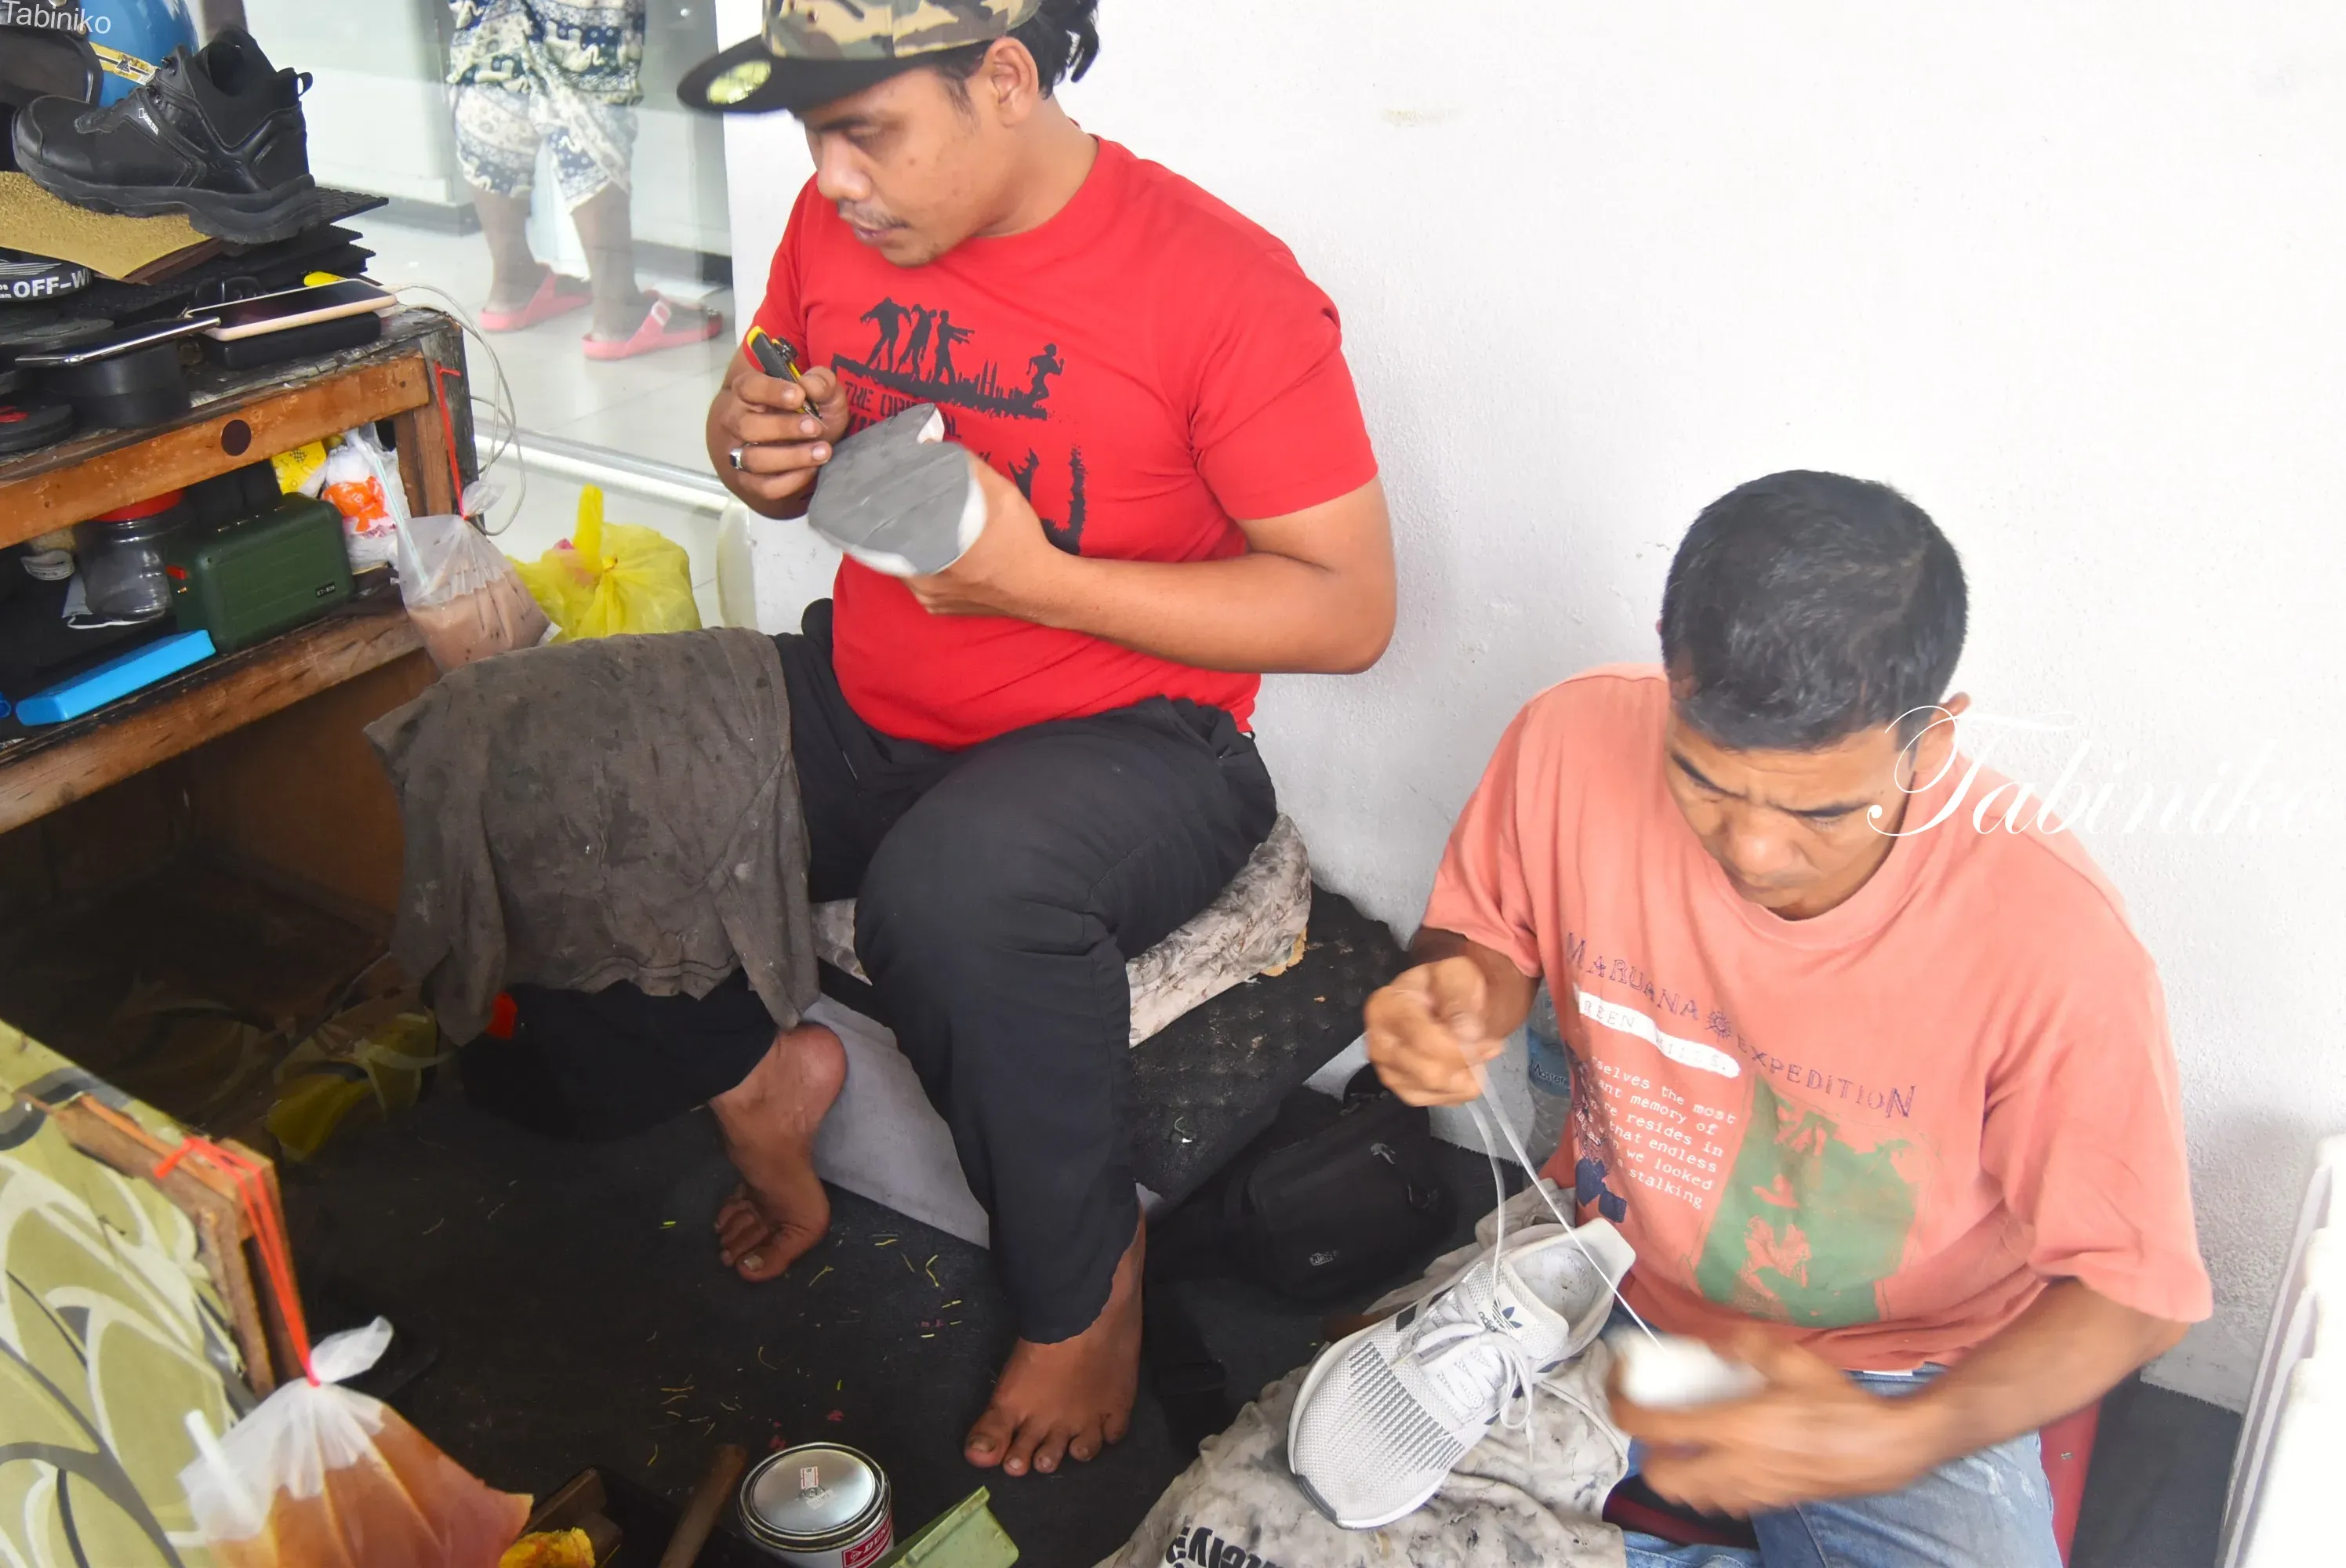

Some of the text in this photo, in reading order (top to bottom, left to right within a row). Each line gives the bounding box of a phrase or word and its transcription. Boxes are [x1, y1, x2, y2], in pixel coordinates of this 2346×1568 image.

[844, 380, 874, 412] THE
[1567, 931, 1916, 1119] MARUANA EXPEDITION
[1583, 999, 1636, 1029] REEN
[1629, 1094, 1688, 1125] memory
[1695, 1121, 1720, 1136] of
[1661, 1085, 1685, 1105] the
[1693, 1103, 1737, 1125] most
[1608, 1120, 1718, 1173] that endless
[1626, 1112, 1692, 1145] resides
[1703, 1141, 1724, 1158] in
[1626, 1149, 1646, 1163] we
[1654, 1157, 1713, 1191] looked
[1629, 1167, 1703, 1210] stalking
